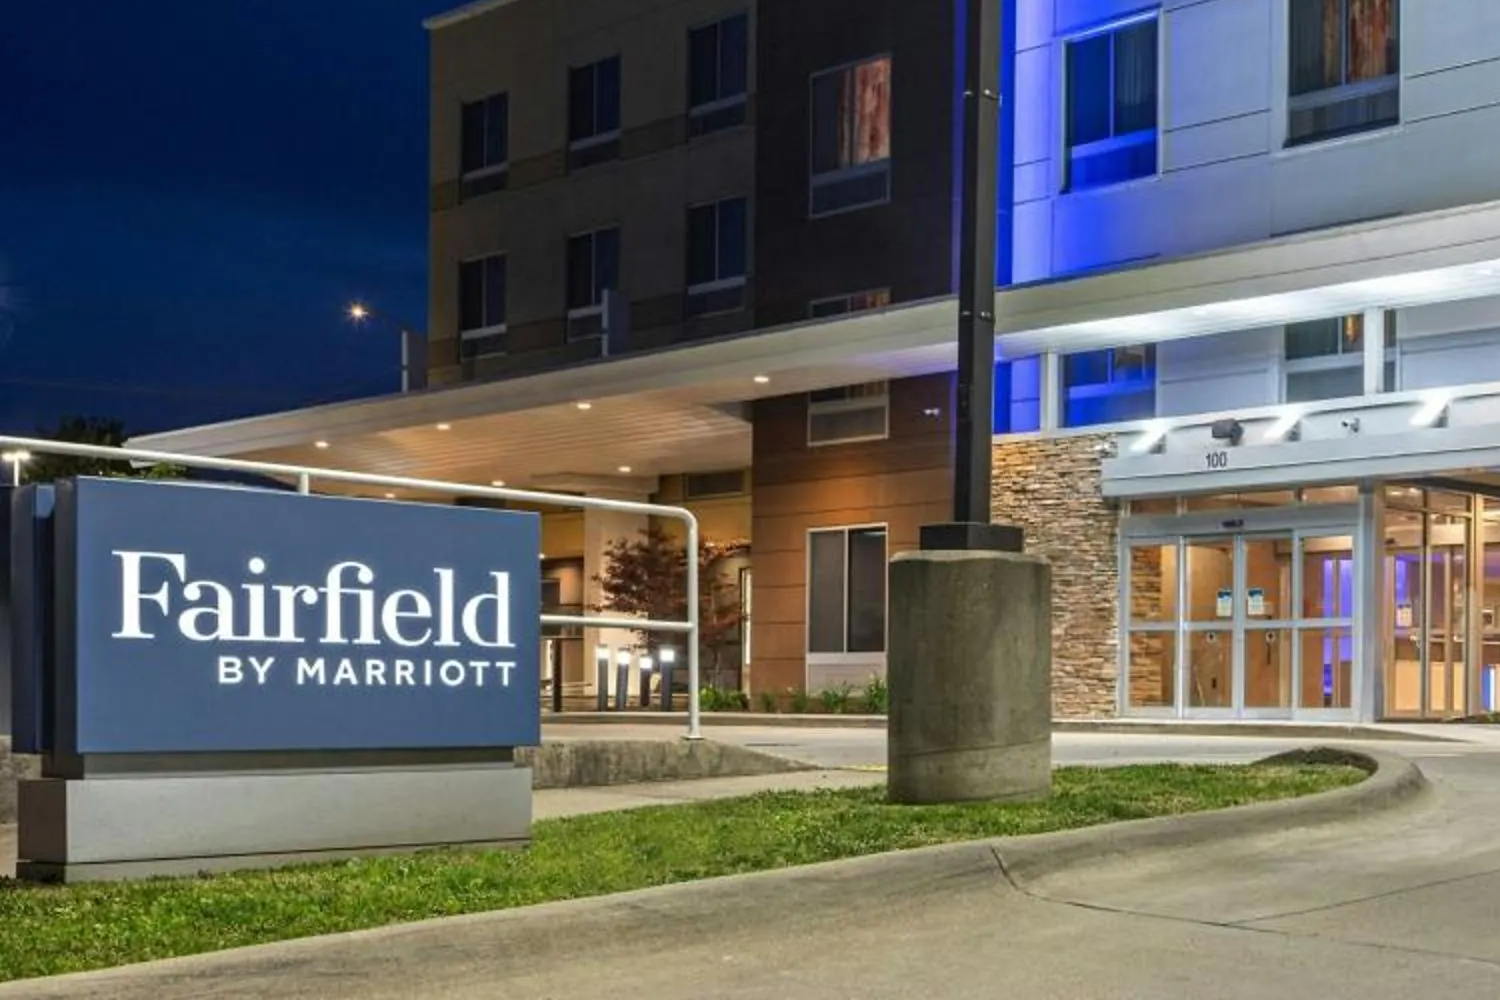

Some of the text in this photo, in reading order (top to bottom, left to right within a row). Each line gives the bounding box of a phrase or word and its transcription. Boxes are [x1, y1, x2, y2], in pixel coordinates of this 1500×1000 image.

[1206, 452, 1227, 468] 100
[111, 550, 516, 648] Fairfield
[218, 656, 517, 687] BY MARRIOTT
